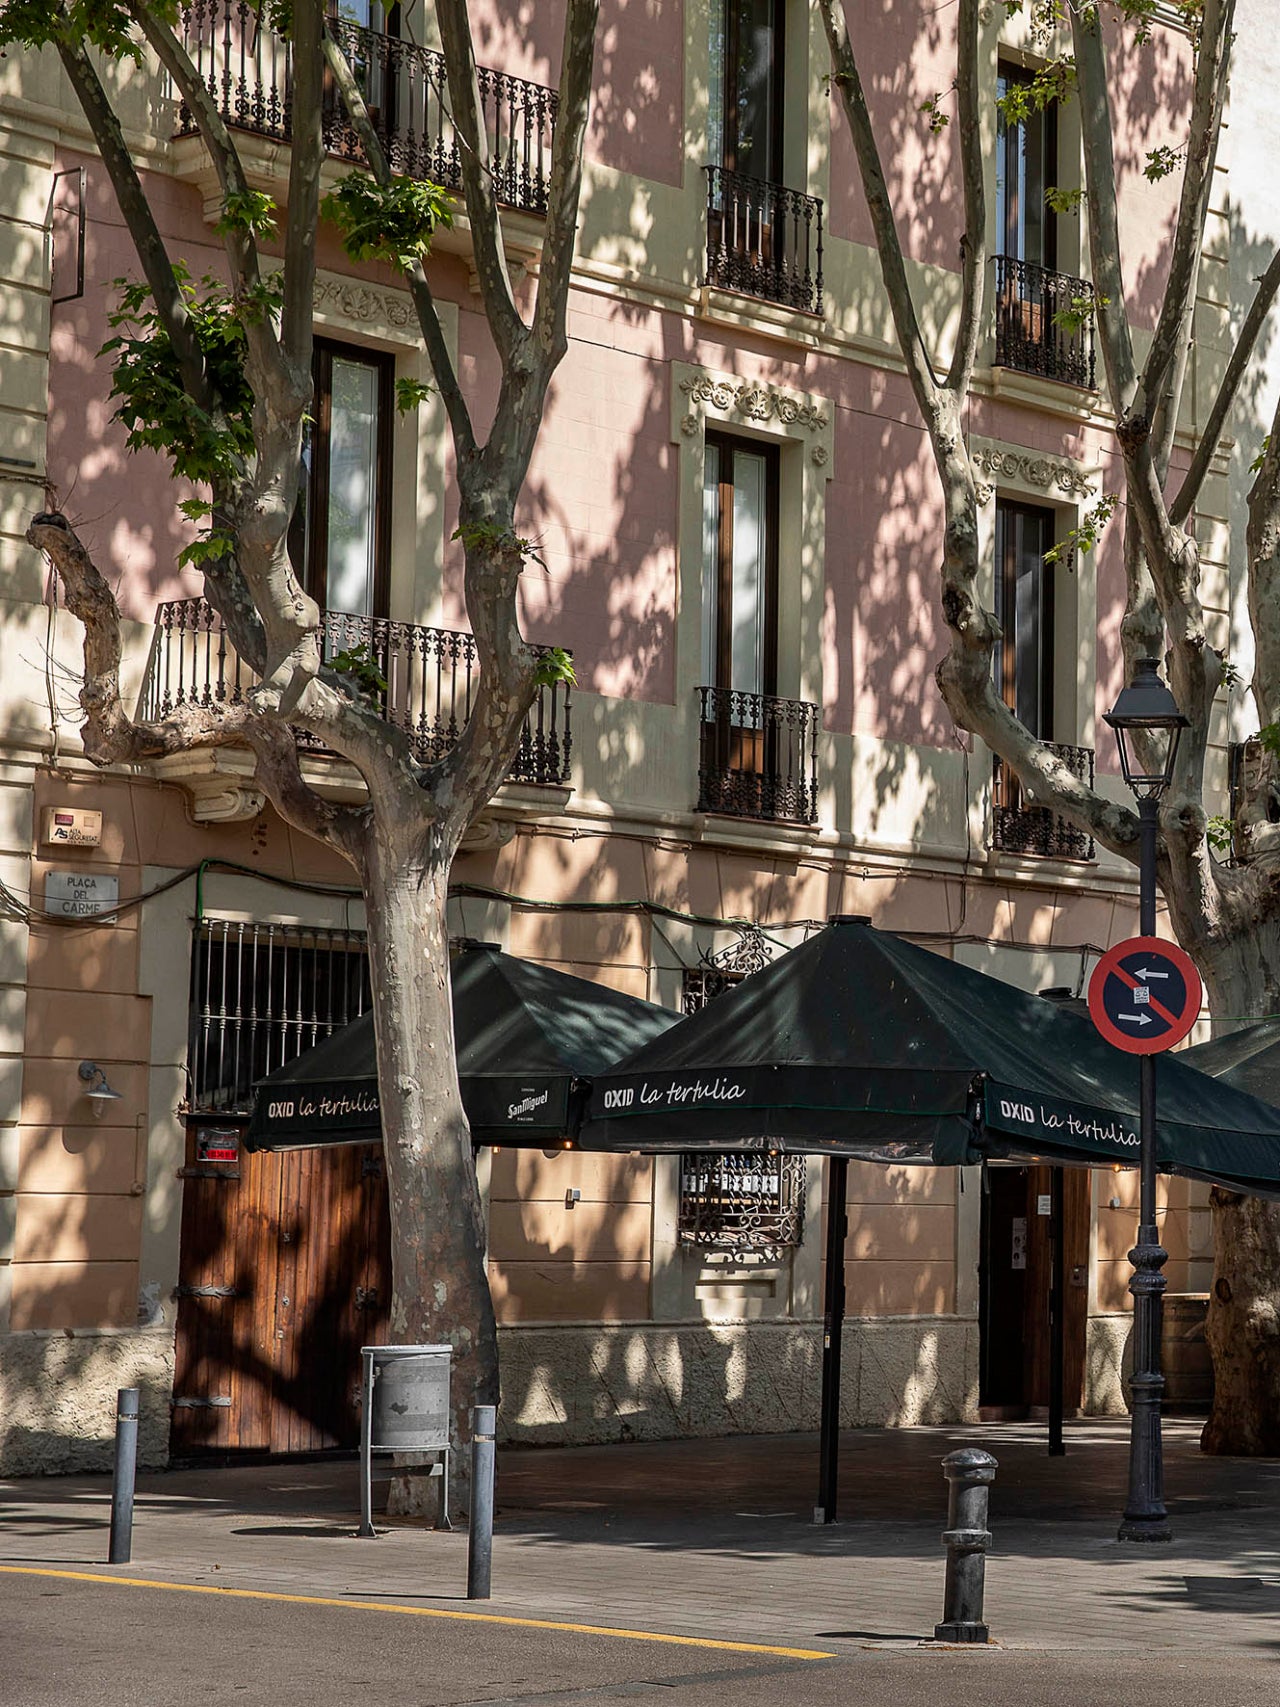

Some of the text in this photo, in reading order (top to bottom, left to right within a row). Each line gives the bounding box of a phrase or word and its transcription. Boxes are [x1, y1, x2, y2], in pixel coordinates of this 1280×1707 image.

[67, 877, 97, 888] PLAÇA
[74, 890, 88, 899] DEL
[63, 902, 100, 914] CARME
[604, 1077, 746, 1108] OXID la tertulia
[268, 1092, 379, 1118] OXID la tertulia
[1000, 1100, 1141, 1146] OXID la tertulia
